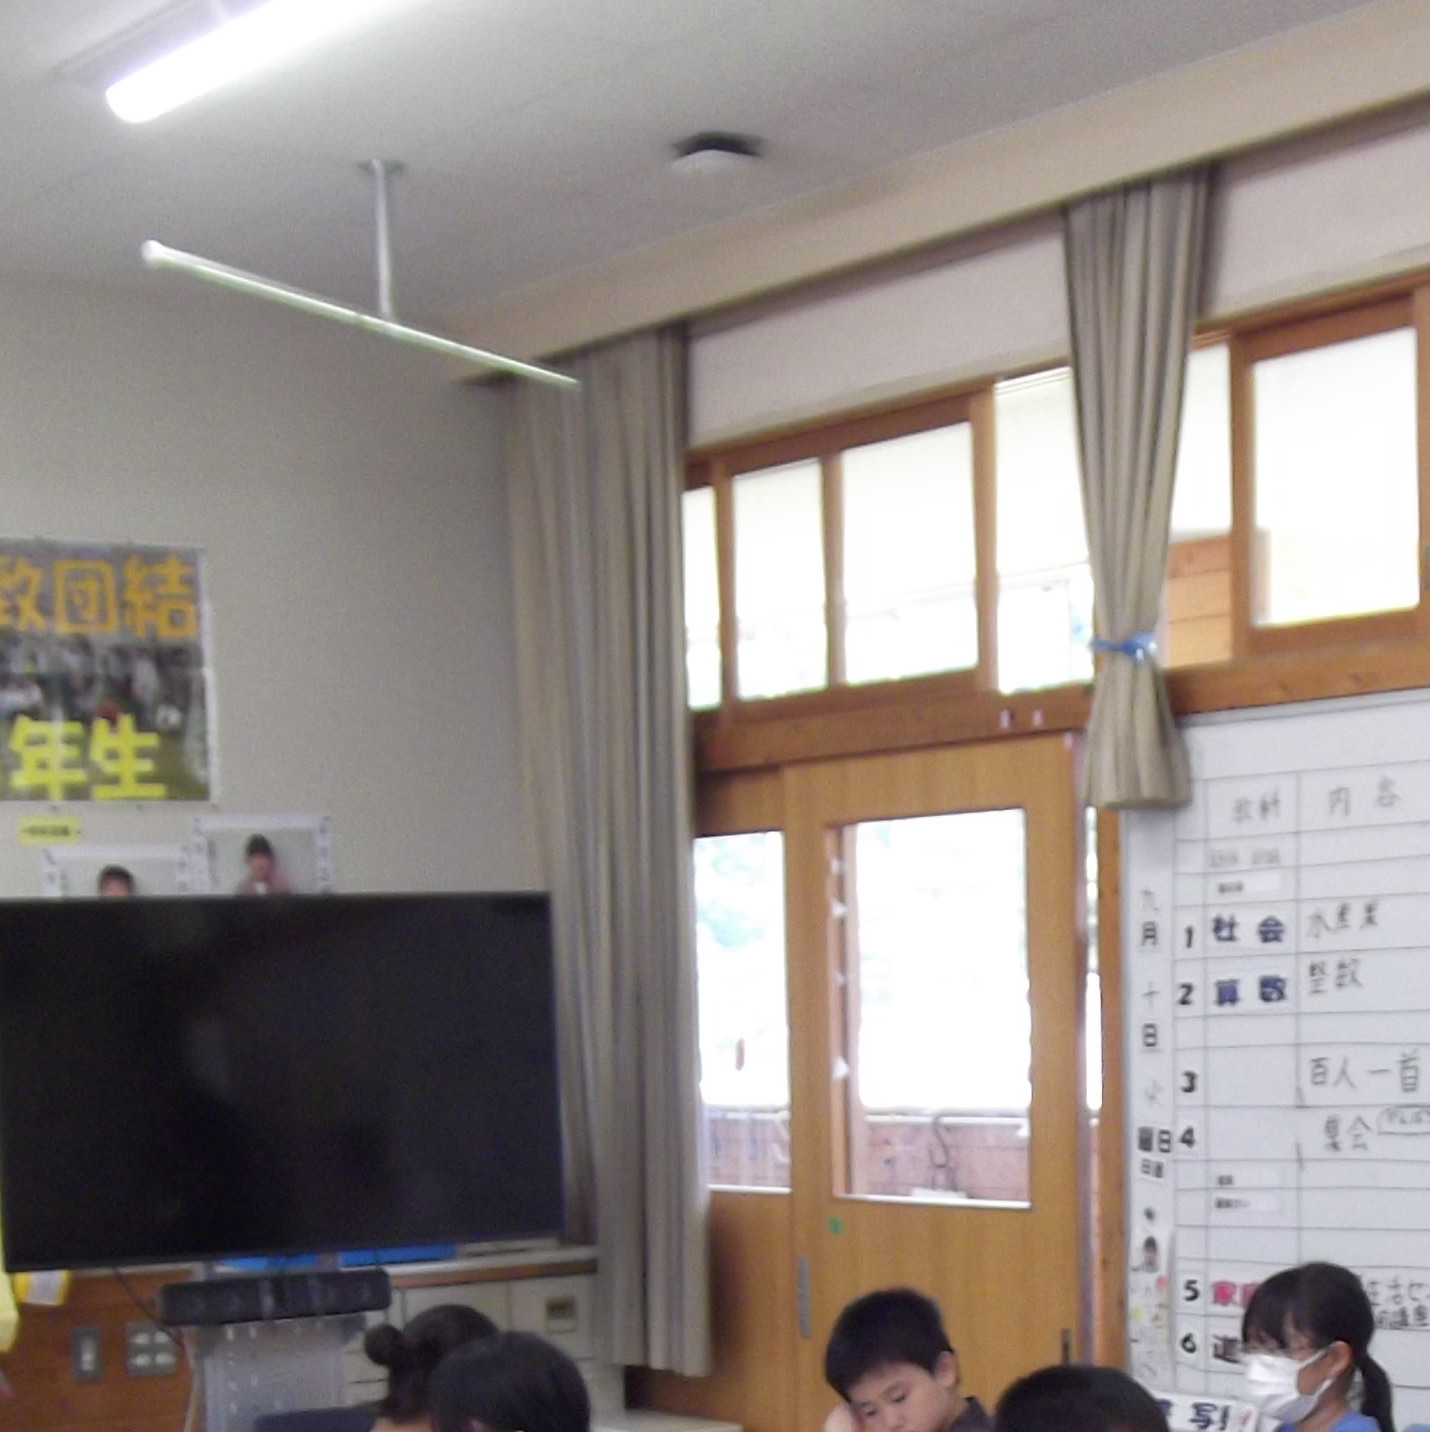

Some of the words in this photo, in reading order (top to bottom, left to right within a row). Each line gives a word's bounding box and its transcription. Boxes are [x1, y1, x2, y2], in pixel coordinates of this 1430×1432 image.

[1183, 925, 1194, 949] 1
[1211, 913, 1285, 944] 社会
[1177, 983, 1194, 1006] 2
[1180, 1070, 1198, 1095] 3
[1309, 1053, 1423, 1094] 百人一首
[1179, 1126, 1197, 1149] 4
[1183, 1279, 1200, 1302] 5
[1180, 1332, 1197, 1355] 6
